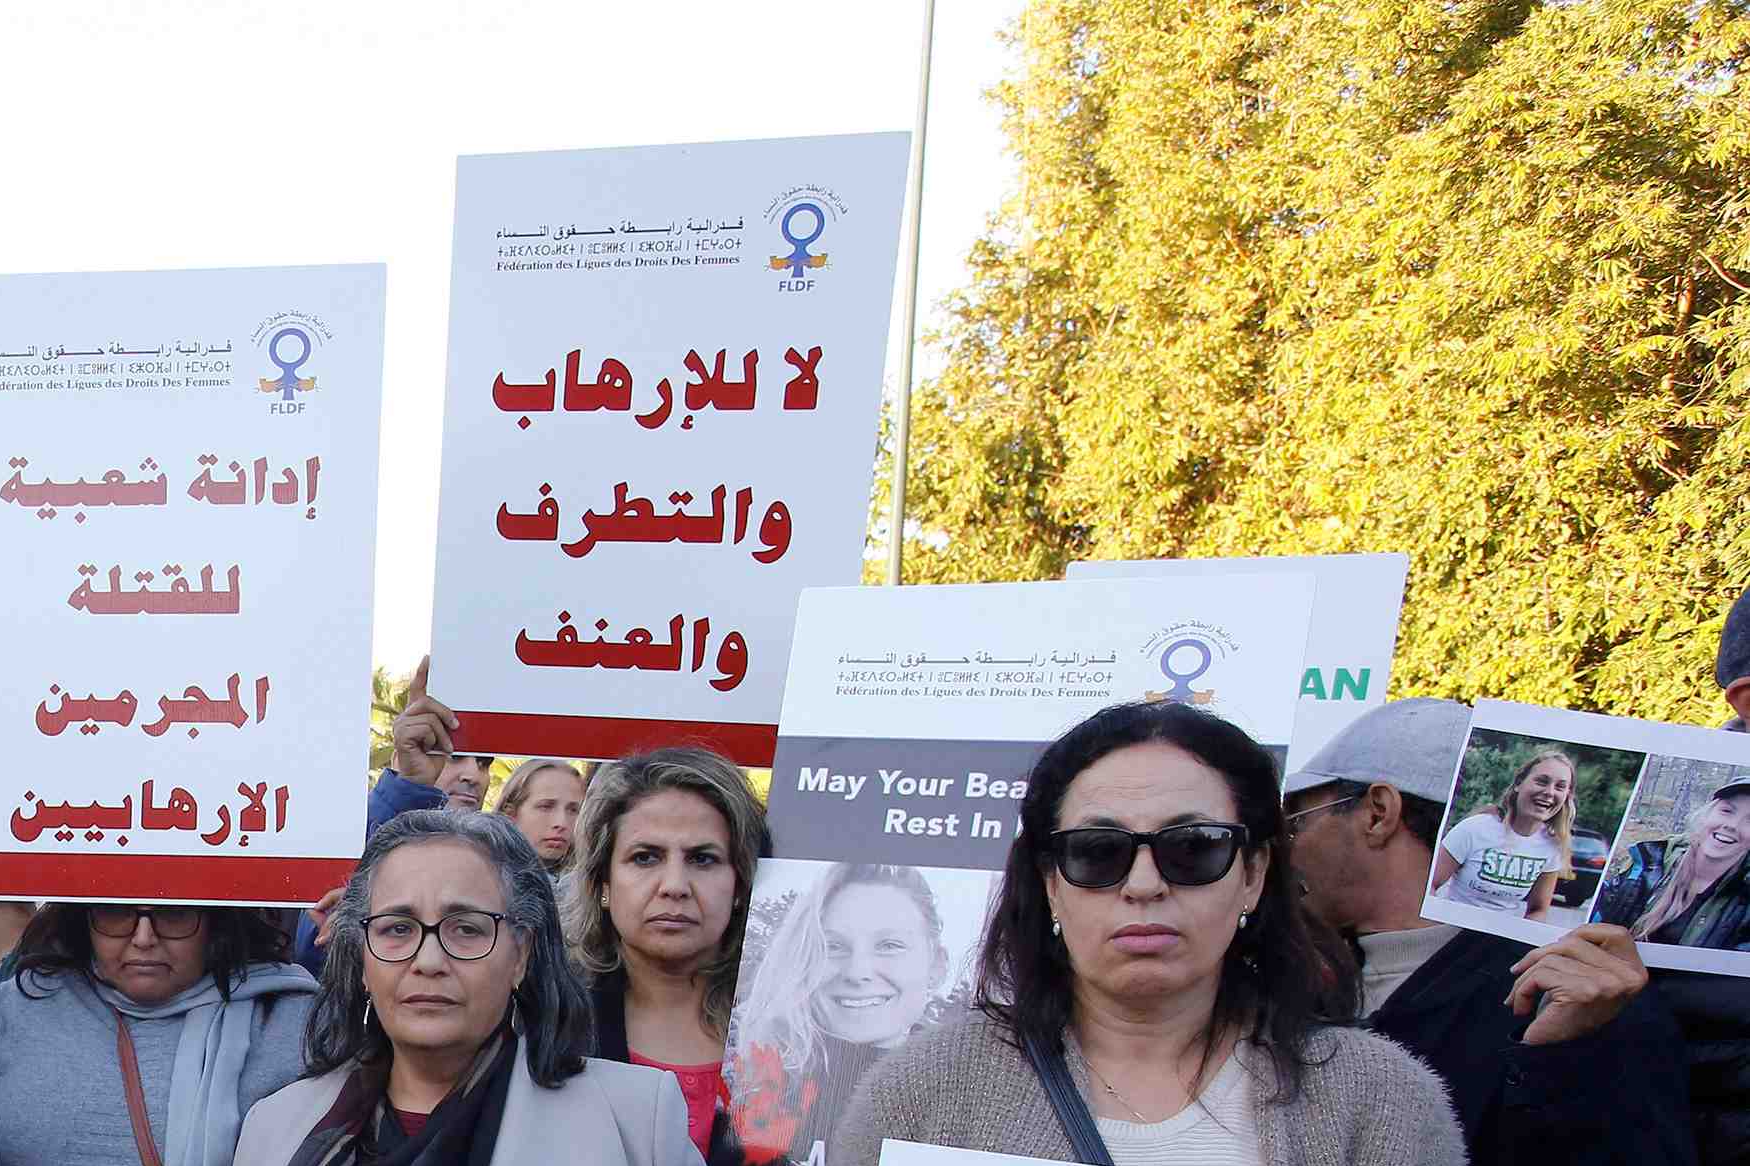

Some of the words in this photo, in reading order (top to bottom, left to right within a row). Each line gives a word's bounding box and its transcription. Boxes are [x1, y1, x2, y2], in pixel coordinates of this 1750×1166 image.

[497, 261, 552, 271] Fédération
[556, 260, 573, 269] des
[577, 259, 611, 270] Ligues
[614, 258, 631, 267] des
[635, 257, 668, 266] Droits
[672, 256, 690, 265] Des
[695, 256, 740, 265] Femmes
[779, 280, 814, 291] FLDF
[46, 380, 64, 389] des
[67, 380, 102, 391] Ligues
[105, 379, 122, 388] des
[126, 378, 159, 392] Droits
[163, 378, 182, 387] Des
[186, 377, 230, 387] Femmes
[493, 349, 759, 430] للإرهاب
[783, 346, 822, 410] لا
[271, 403, 305, 414] FLDF
[187, 454, 320, 519] إدانة
[497, 482, 792, 564] والتطرف
[67, 564, 240, 614] للقتلة
[515, 611, 748, 691] والعنف
[36, 673, 270, 739] المجرمين
[836, 686, 897, 695] Fédération
[901, 687, 921, 696] des
[924, 687, 962, 698] Ligues
[966, 688, 985, 696] des
[990, 688, 1027, 696] Droits
[1031, 688, 1053, 696] Des
[1058, 688, 1109, 697] Femmes
[798, 768, 866, 800] May
[879, 770, 954, 796] Your
[10, 780, 289, 847] الإرهابيين
[885, 809, 959, 836] Rest
[971, 813, 1001, 838] In
[1483, 848, 1546, 881] STAFF
